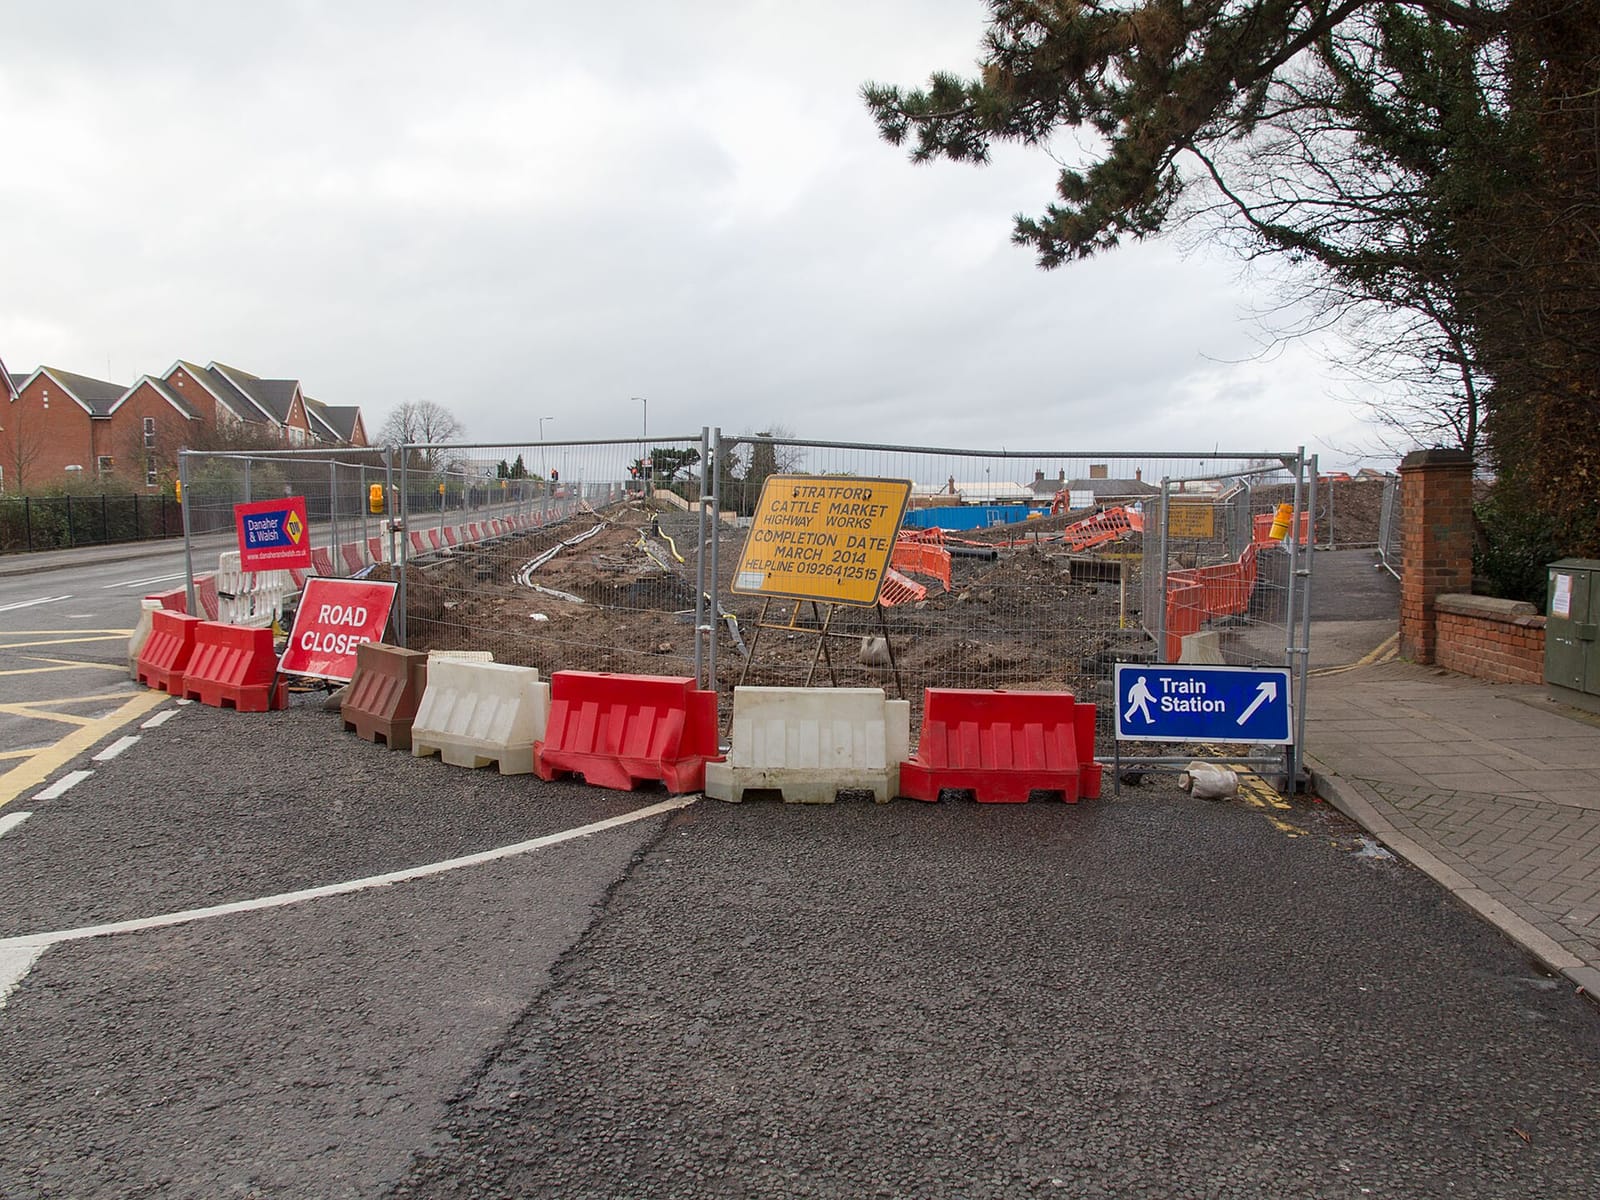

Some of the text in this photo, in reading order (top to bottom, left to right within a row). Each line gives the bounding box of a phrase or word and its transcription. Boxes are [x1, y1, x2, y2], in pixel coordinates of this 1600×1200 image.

[793, 486, 872, 501] STRATFORD
[771, 500, 888, 518] CATTLE MARKET
[248, 518, 278, 531] Danaher
[763, 514, 872, 530] HIGHWAY WORKS
[249, 530, 279, 543] & Walsh
[754, 530, 838, 547] COMPLETION
[774, 546, 866, 565] MARCH 2014
[745, 560, 793, 573] HELPLINE
[318, 604, 367, 627] ROAD
[1159, 677, 1206, 693] Train
[1160, 696, 1225, 712] Station
